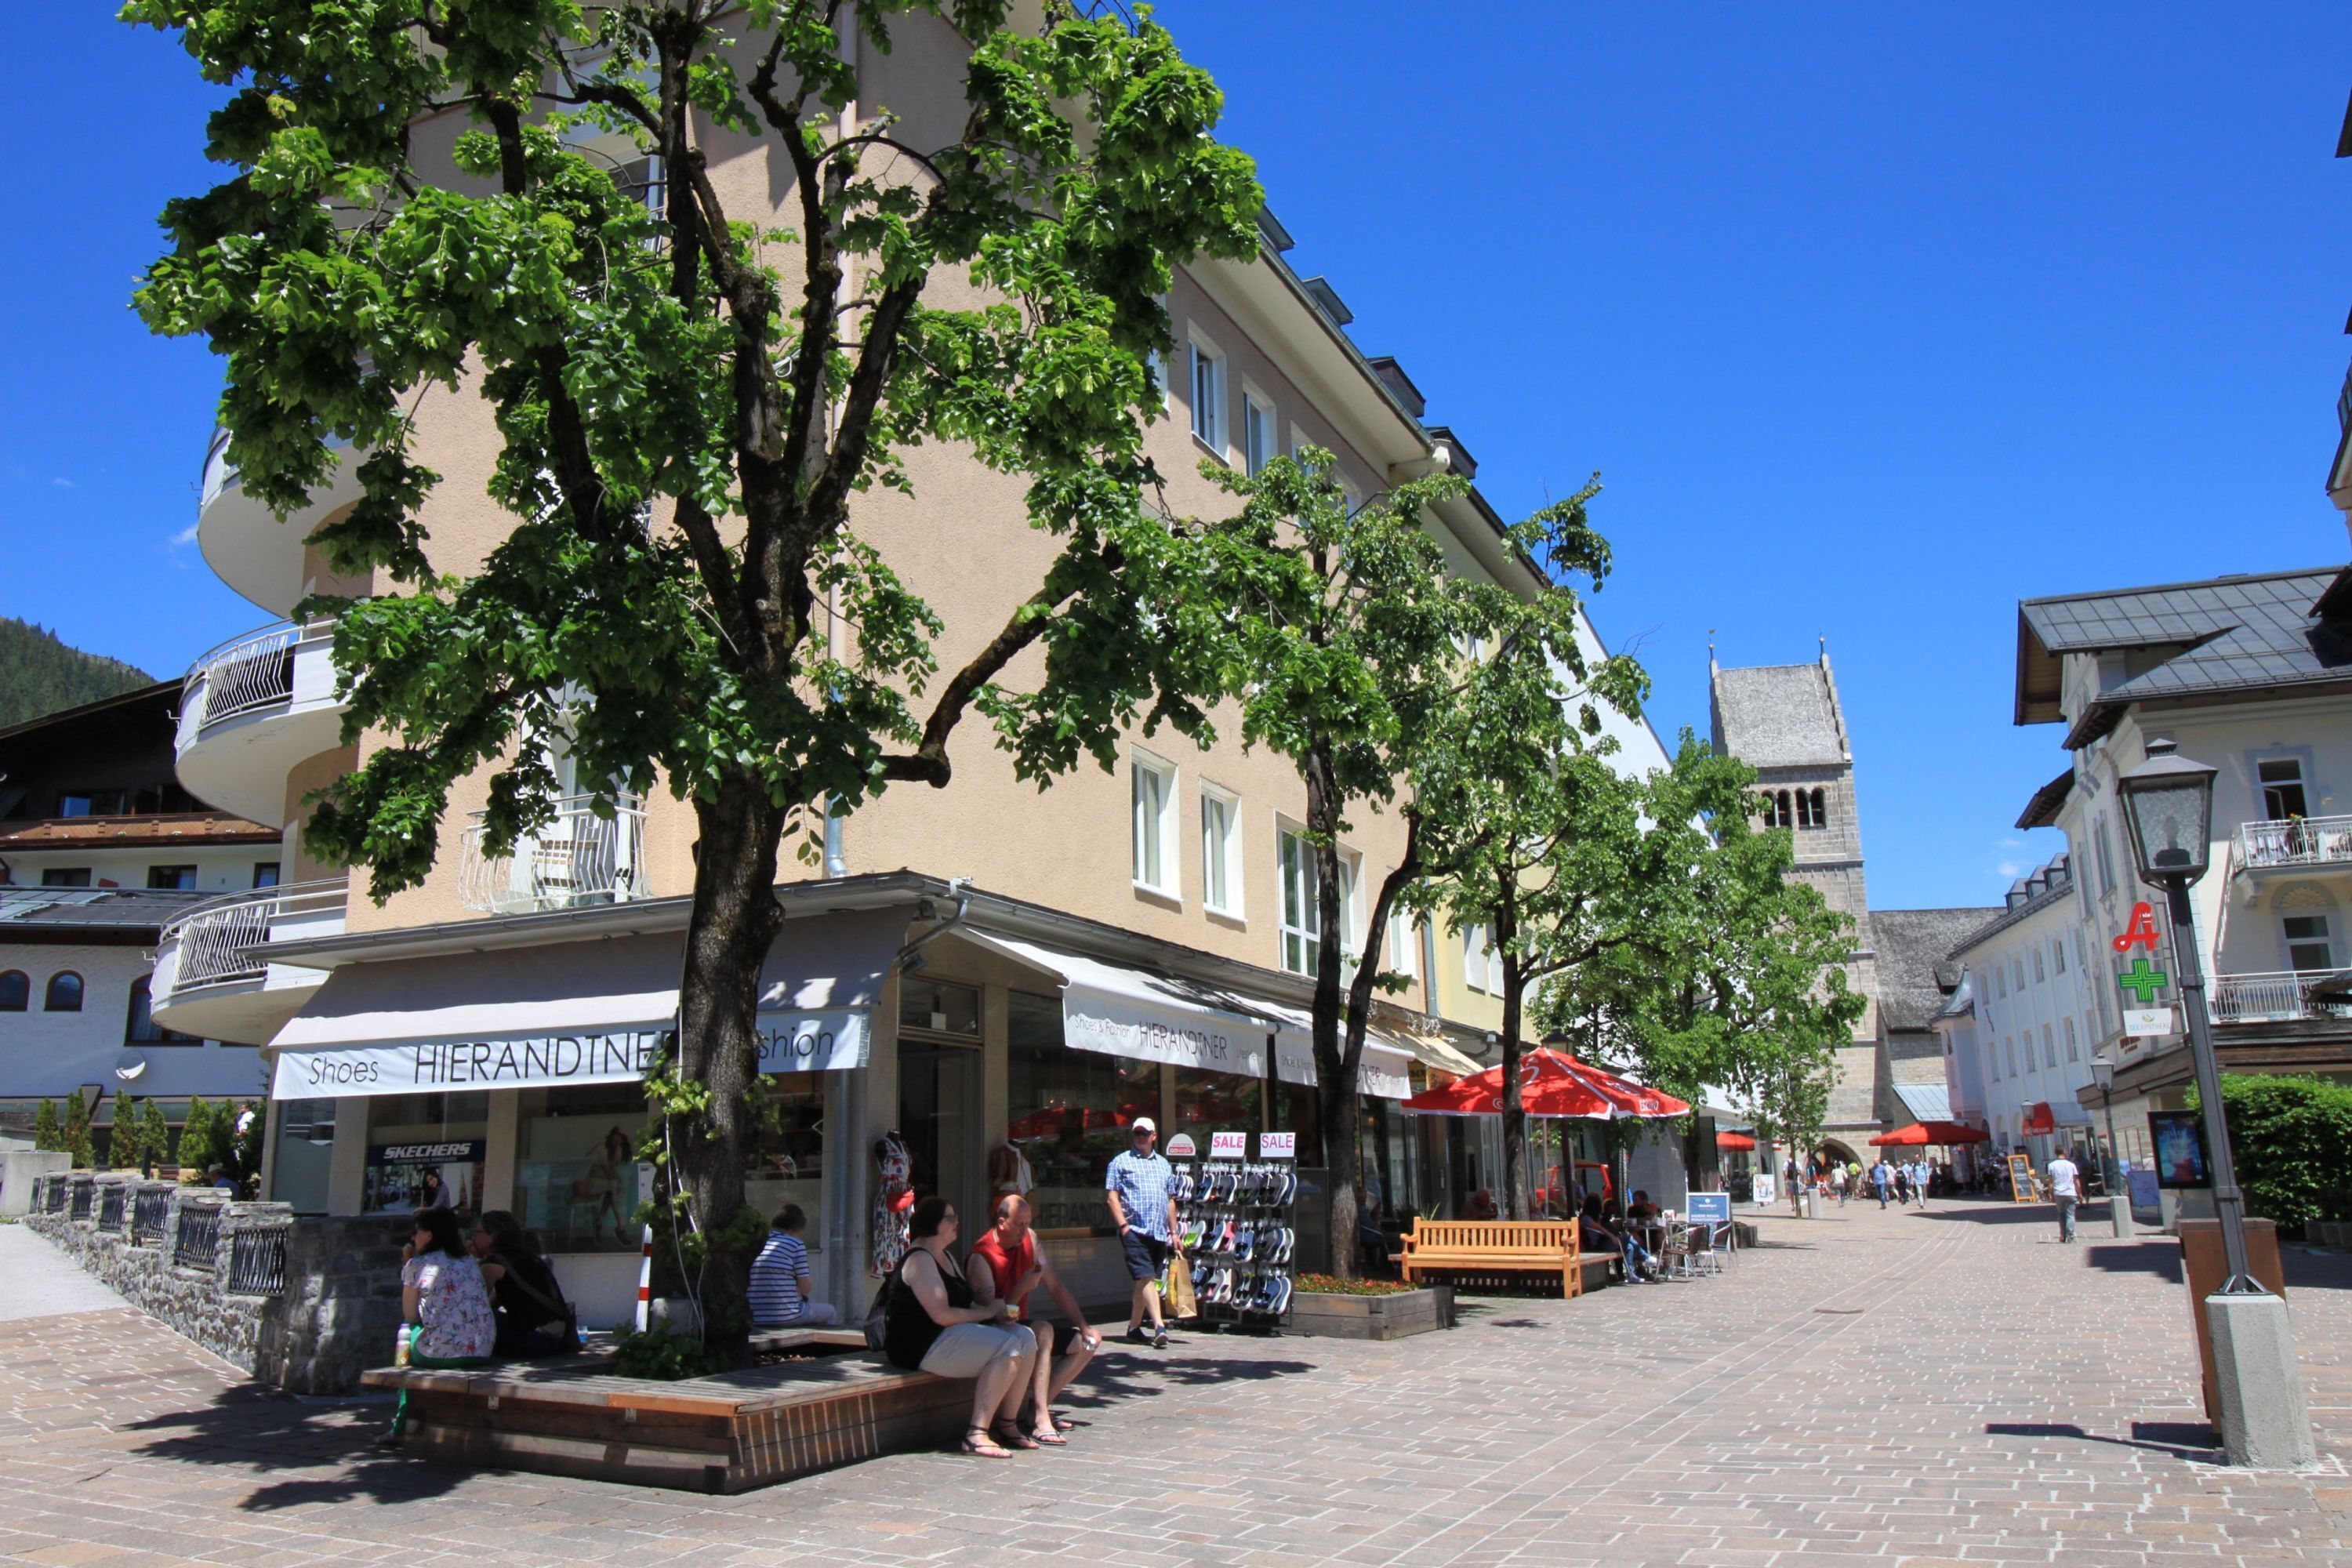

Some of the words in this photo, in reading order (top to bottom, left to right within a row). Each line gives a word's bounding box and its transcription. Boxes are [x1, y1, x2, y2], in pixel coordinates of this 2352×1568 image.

[1138, 1021, 1228, 1061] HIERANDTNER
[308, 1056, 379, 1085] Shoes
[757, 1026, 833, 1059] shion
[1213, 1136, 1244, 1149] SALE
[1261, 1135, 1293, 1149] SALE
[383, 1143, 472, 1159] SKECHERS
